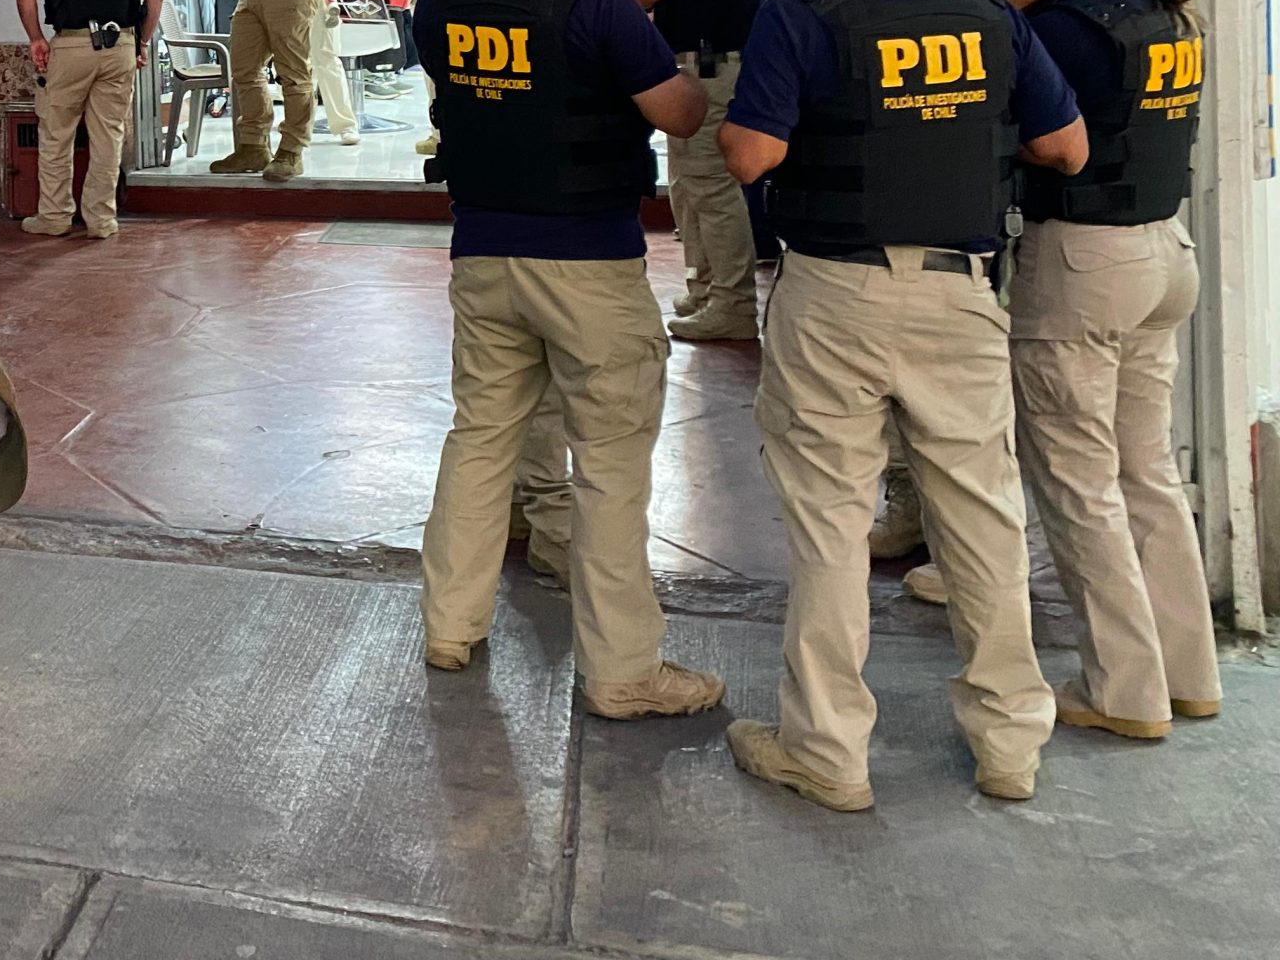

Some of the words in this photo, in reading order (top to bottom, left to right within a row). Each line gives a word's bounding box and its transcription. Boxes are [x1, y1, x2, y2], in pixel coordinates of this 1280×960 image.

[447, 23, 531, 73] PDI
[877, 31, 986, 88] PDI
[1145, 37, 1202, 92] PDI
